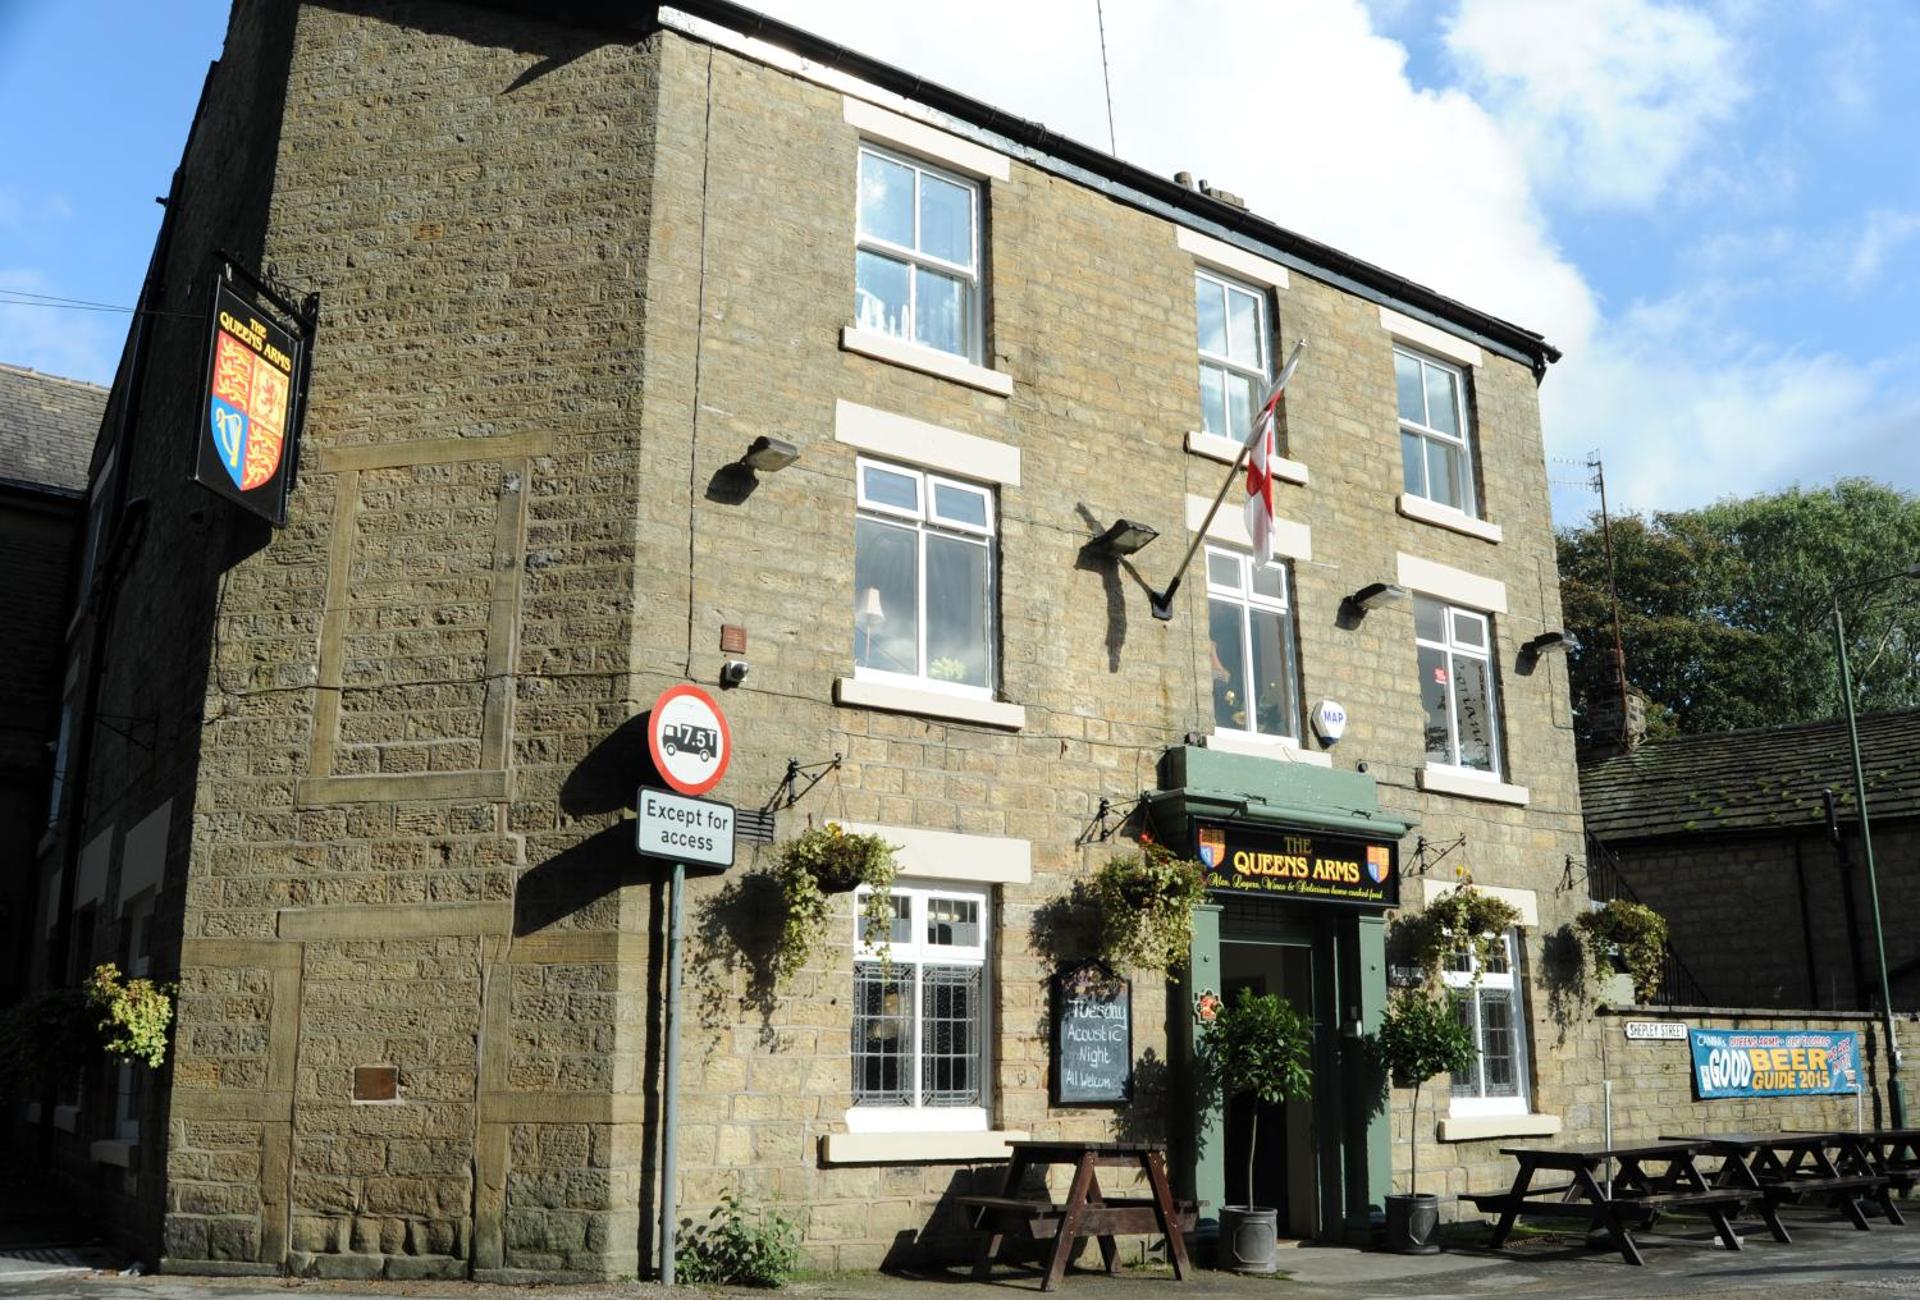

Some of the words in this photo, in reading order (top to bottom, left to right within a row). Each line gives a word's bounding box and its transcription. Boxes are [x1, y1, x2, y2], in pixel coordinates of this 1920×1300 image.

[249, 317, 267, 339] THE
[220, 312, 263, 351] QUEENS
[264, 343, 291, 371] ARMS
[1324, 710, 1344, 723] MAP
[647, 799, 702, 828] Except
[708, 811, 728, 830] for
[661, 829, 713, 851] access
[1284, 836, 1312, 854] THE
[1234, 851, 1309, 879] QUEENS
[1312, 858, 1360, 883] ARMS
[1068, 1000, 1127, 1030] Tuesday
[1067, 1023, 1123, 1043] Acoustic
[1630, 1023, 1659, 1037] SHEPLEY
[1660, 1024, 1685, 1038] STREET
[1079, 1047, 1111, 1068] Night
[1709, 1049, 1751, 1088] GOOD
[1749, 1048, 1828, 1071] BEER
[1065, 1069, 1078, 1087] All
[1752, 1070, 1796, 1090] GUIDE
[1800, 1069, 1830, 1089] 2015
